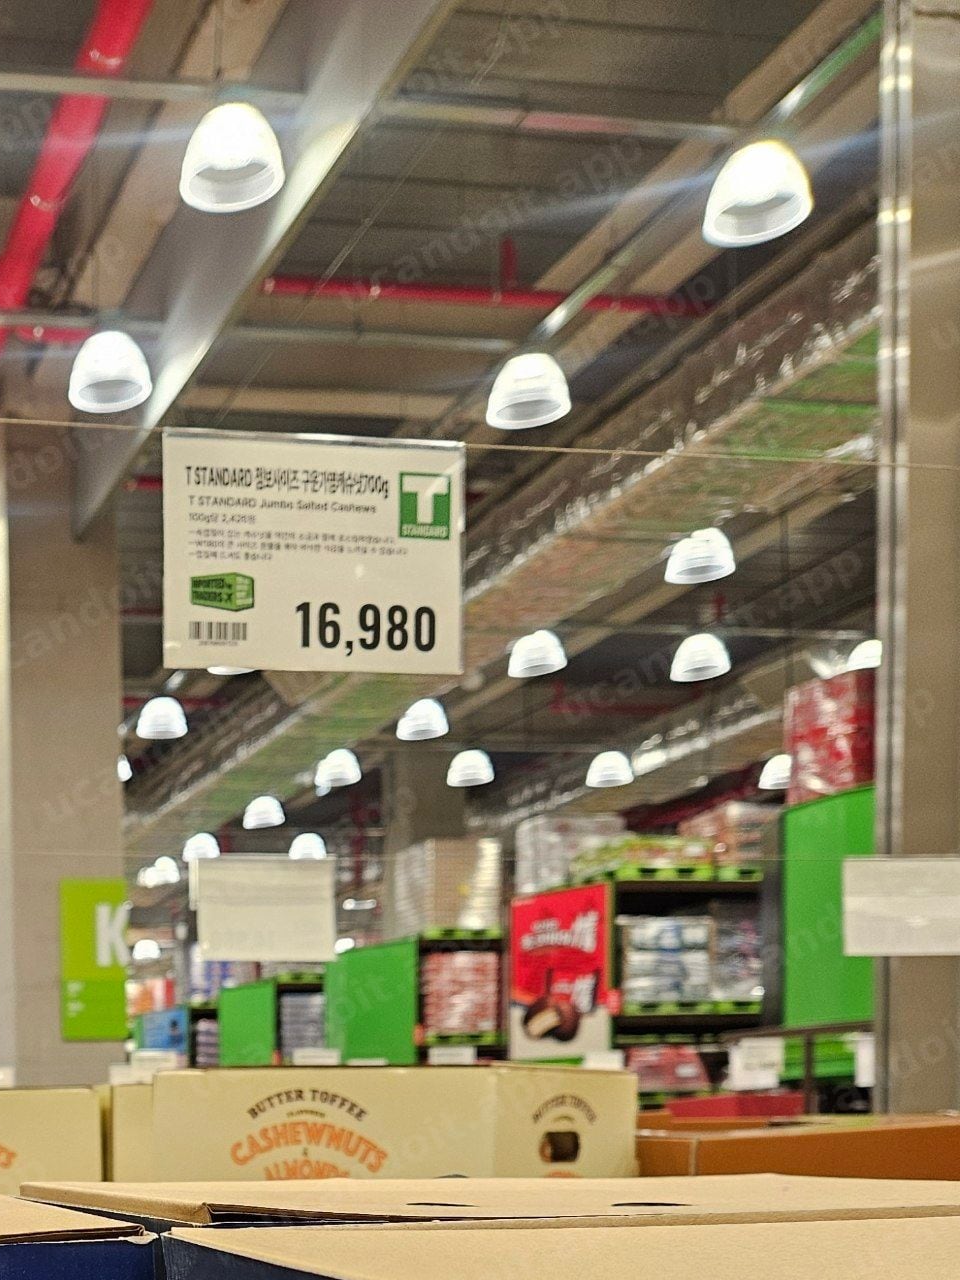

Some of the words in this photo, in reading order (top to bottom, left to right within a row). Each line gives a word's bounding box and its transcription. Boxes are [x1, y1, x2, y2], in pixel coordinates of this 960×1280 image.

[186, 466, 192, 486] T
[194, 466, 252, 487] STANDARD
[255, 467, 299, 492] 점보사이즈
[295, 602, 436, 656] 16,980
[95, 902, 131, 968] K
[247, 1089, 305, 1119] BUTTER
[309, 1088, 368, 1122] TOFFEE
[230, 1120, 388, 1174] CASHEWNUTS
